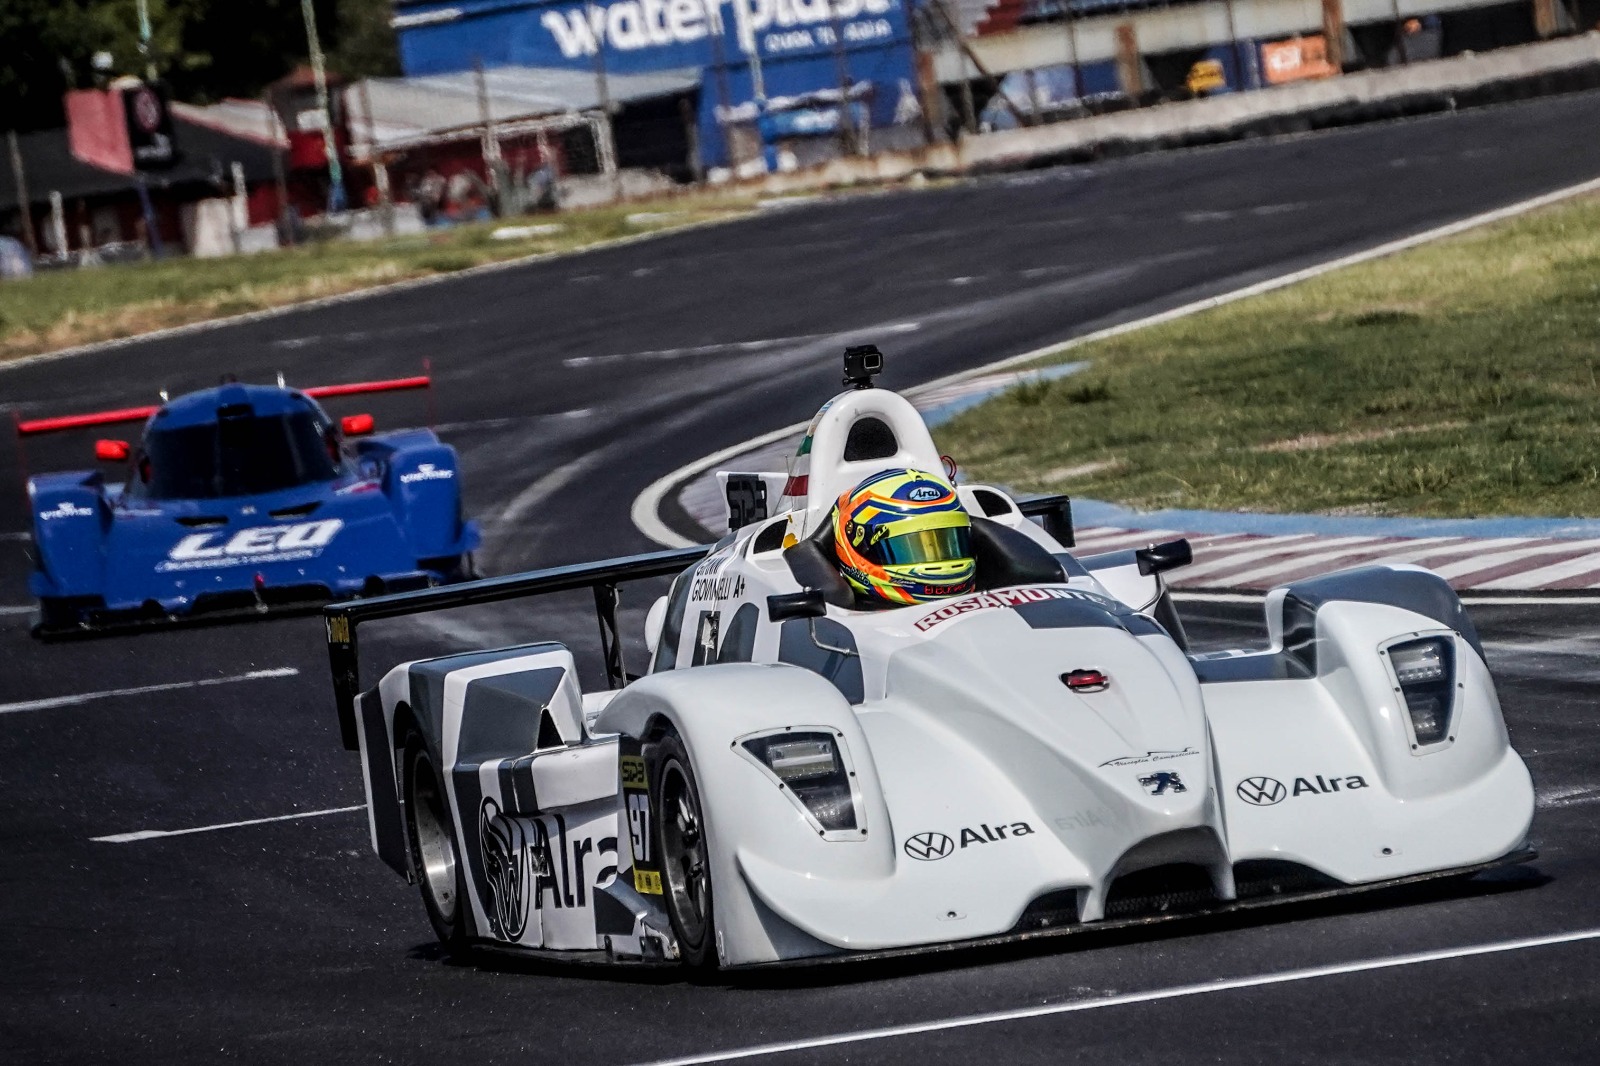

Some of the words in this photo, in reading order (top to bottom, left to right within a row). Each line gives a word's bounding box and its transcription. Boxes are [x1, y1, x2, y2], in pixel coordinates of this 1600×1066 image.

[541, 0, 893, 58] waterpa
[911, 488, 940, 500] Arai
[168, 518, 344, 560] LEO
[733, 574, 746, 599] A+
[1292, 774, 1370, 797] Alra
[628, 794, 651, 863] 97
[959, 821, 1036, 849] Alra
